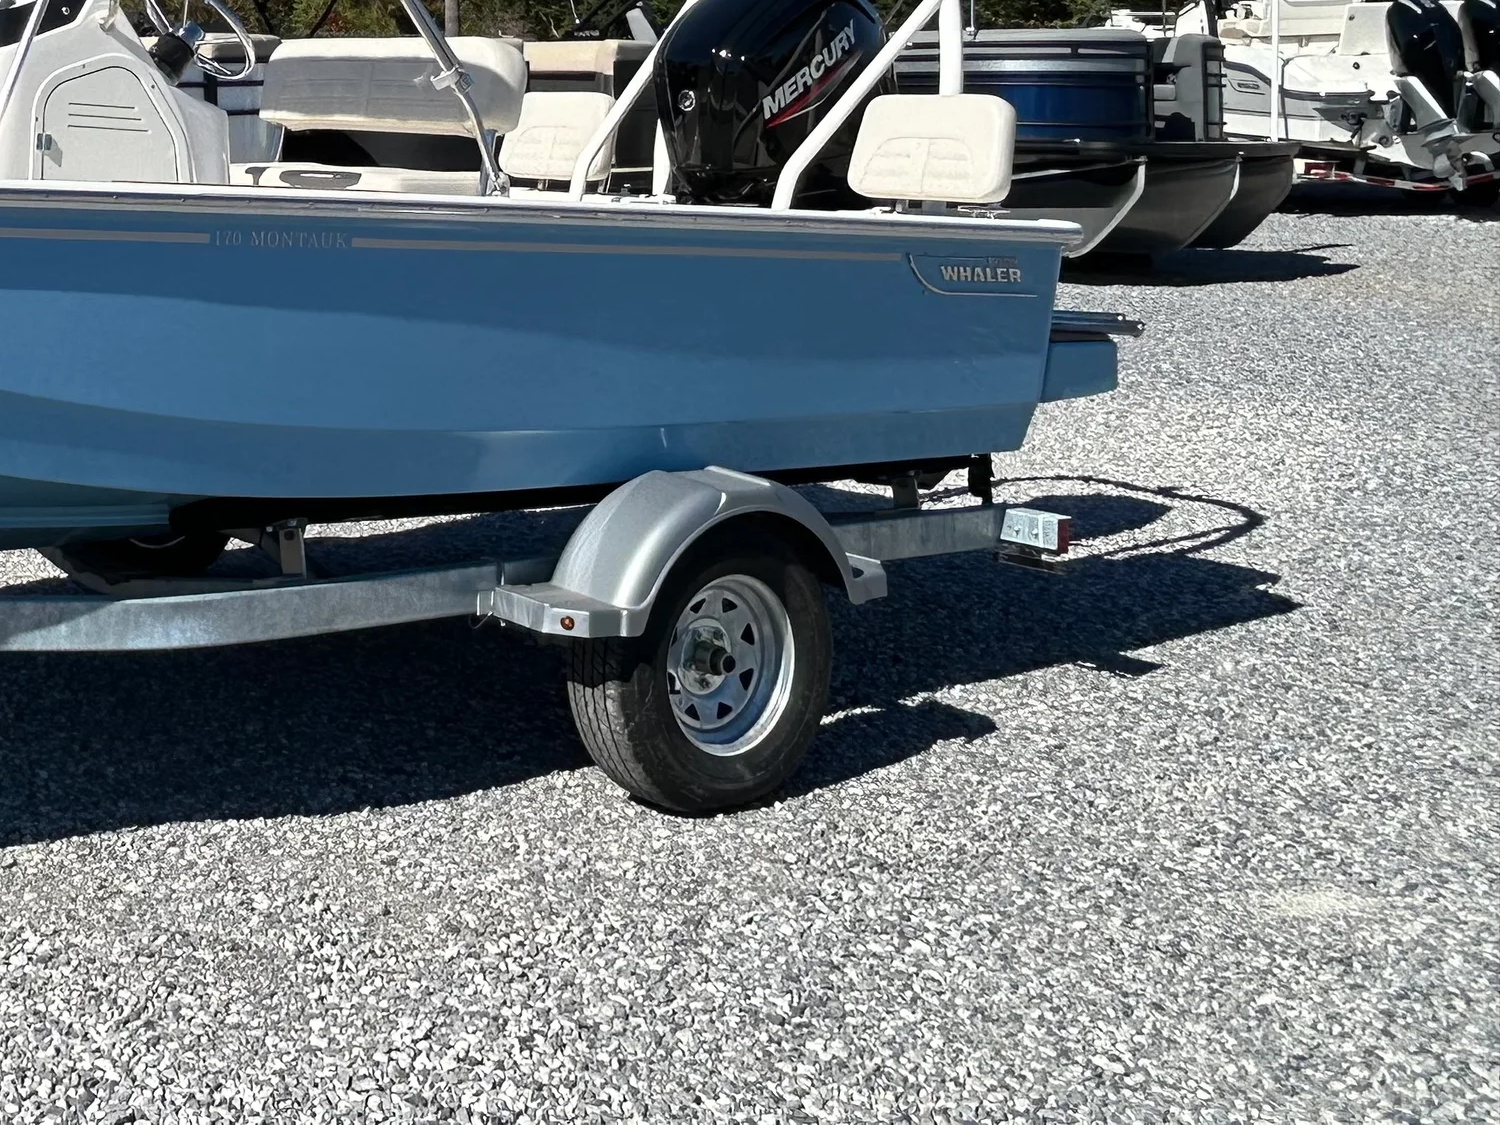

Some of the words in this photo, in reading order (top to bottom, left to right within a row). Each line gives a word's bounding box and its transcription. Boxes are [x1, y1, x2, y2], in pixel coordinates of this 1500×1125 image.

[762, 18, 855, 120] MERCURY
[215, 230, 242, 246] 170
[251, 230, 348, 248] MONTAUK
[940, 265, 1021, 283] WHALER
